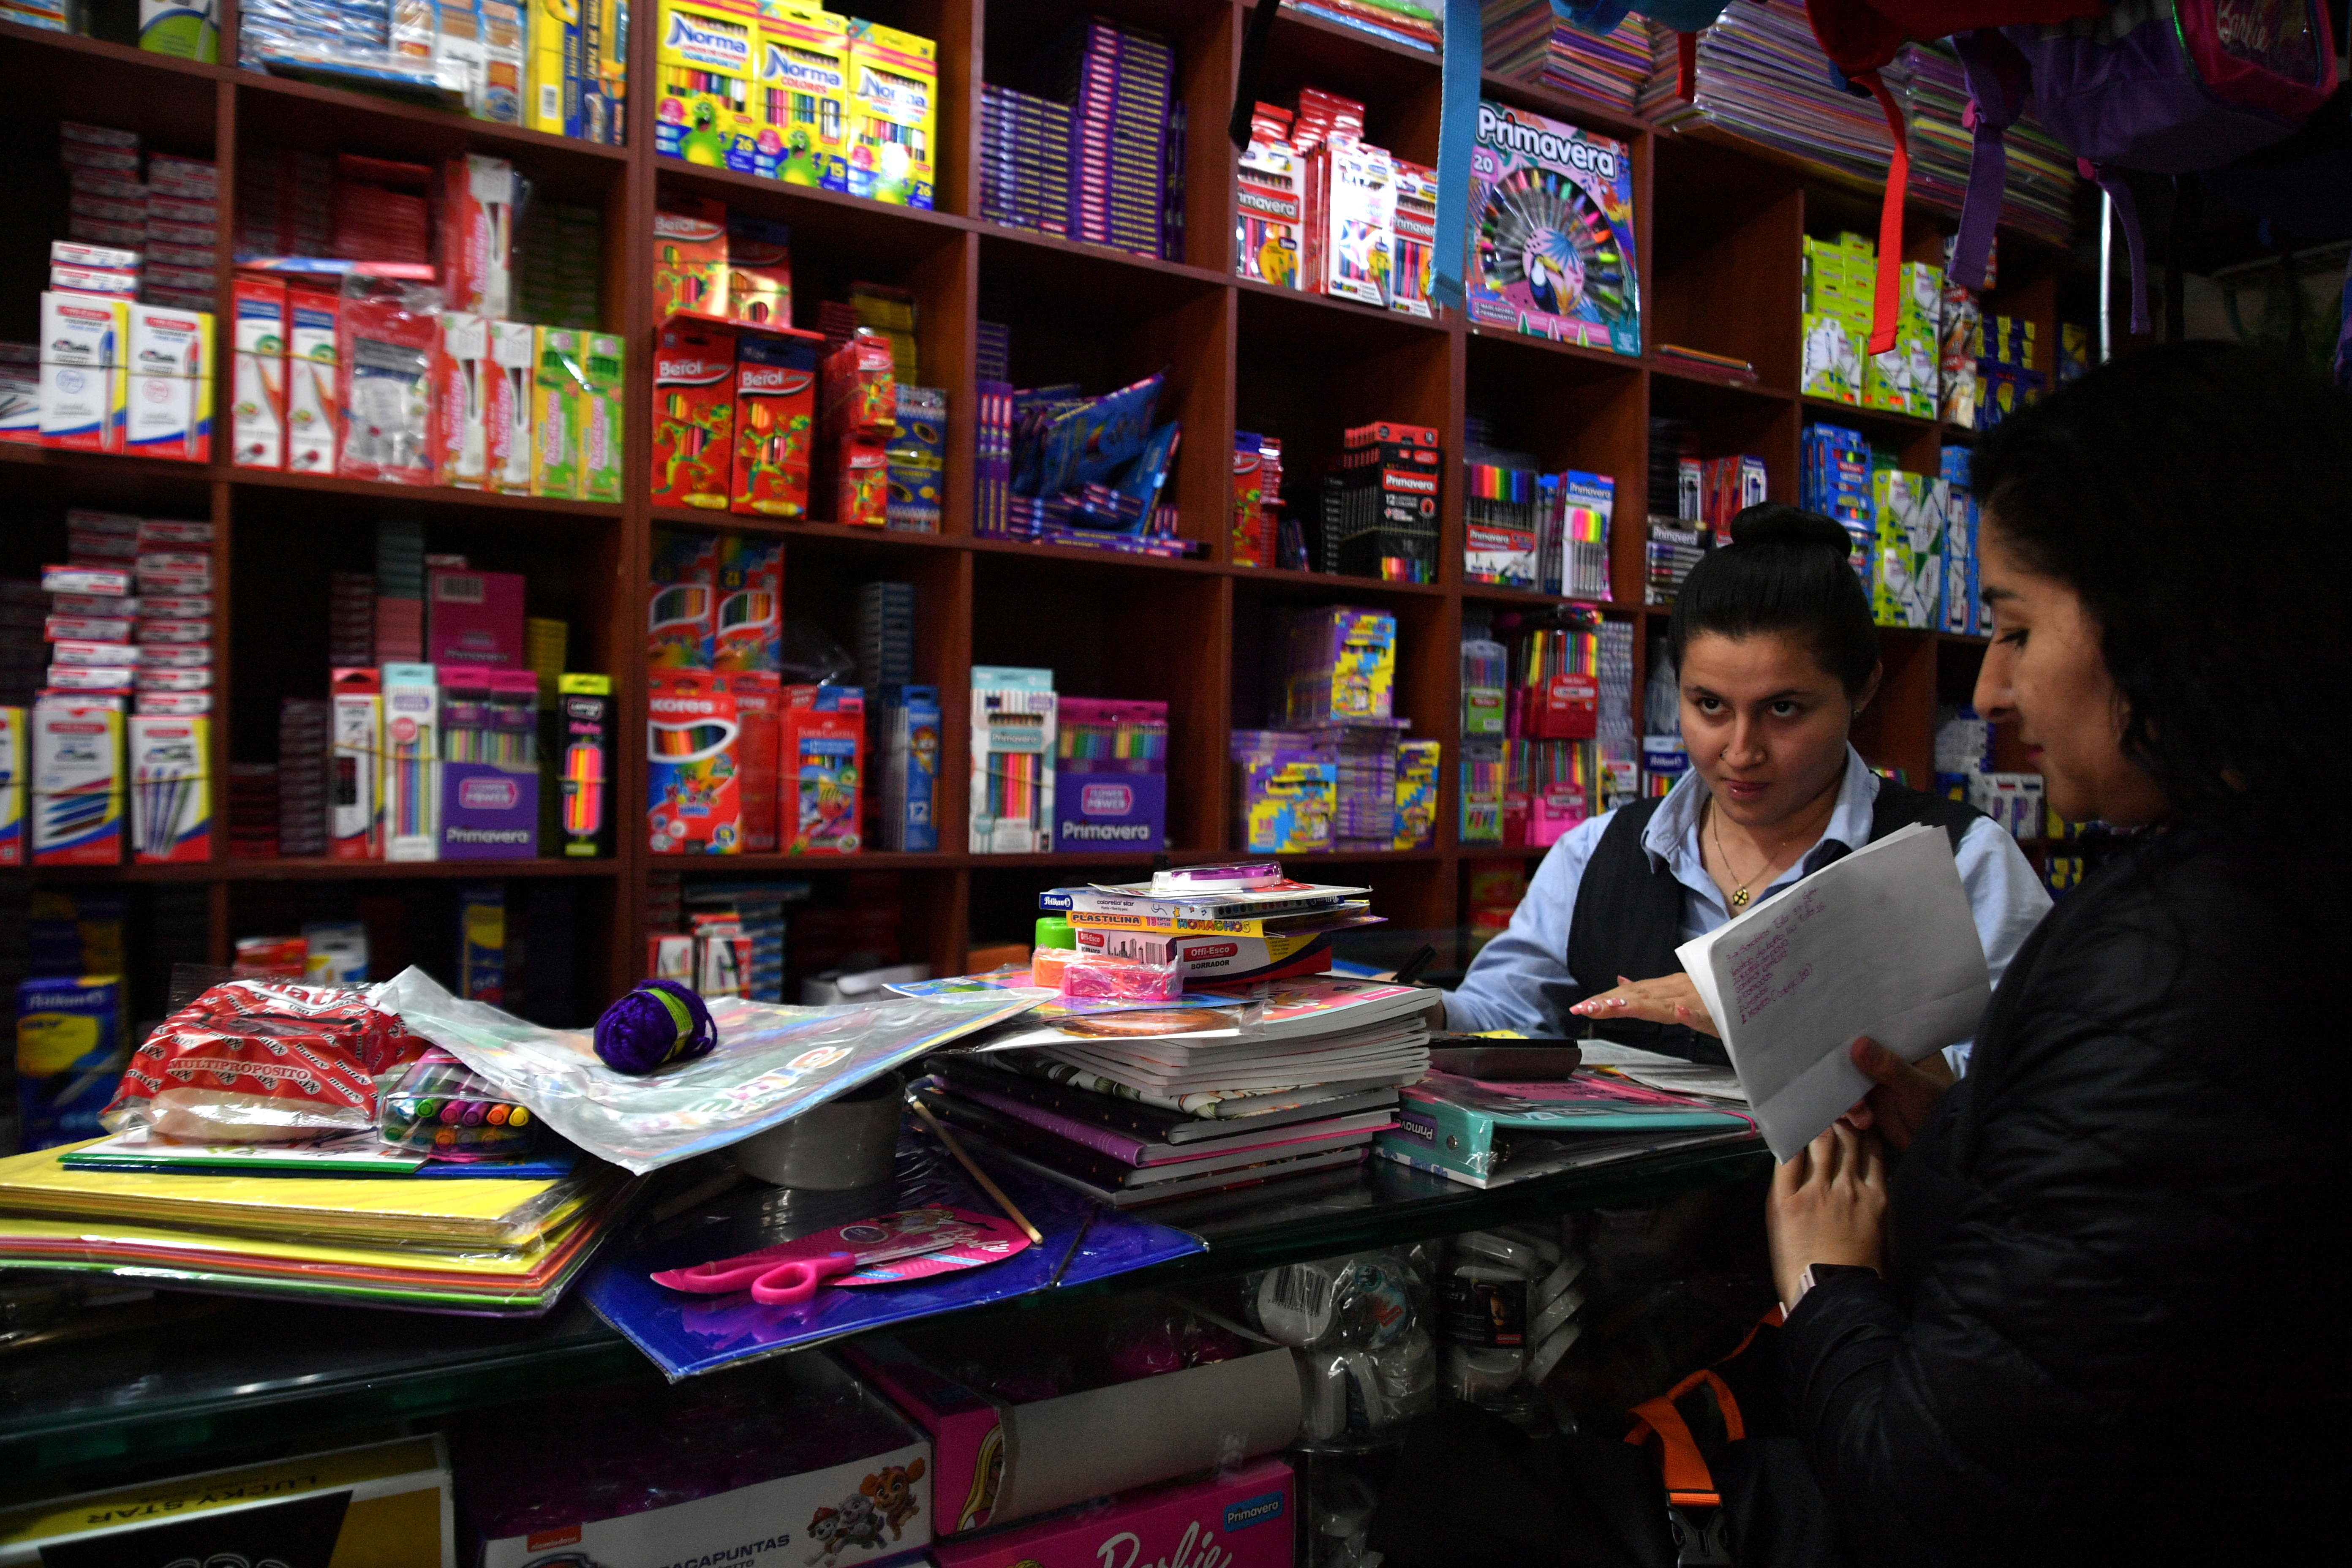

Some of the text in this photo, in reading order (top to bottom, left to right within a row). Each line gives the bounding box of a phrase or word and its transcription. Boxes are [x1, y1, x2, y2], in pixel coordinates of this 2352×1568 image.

[666, 13, 747, 53] Norma
[763, 44, 840, 86] Norma
[781, 76, 827, 94] COLORES
[736, 137, 754, 152] 26
[1478, 105, 1615, 178] Primavera
[830, 162, 845, 177] 15
[1473, 153, 1494, 174] 20
[917, 182, 931, 197] 26
[1238, 191, 1296, 217] imavera
[656, 215, 696, 232] Berol
[659, 359, 703, 376] Berol
[742, 370, 783, 387] Berol
[1386, 474, 1434, 491] Primavera
[1569, 482, 1612, 499] Primavera
[1470, 529, 1510, 544] Primavera
[1653, 527, 1697, 545] Primavera
[992, 733, 1037, 743] Primavera
[909, 801, 928, 822] 12
[446, 826, 530, 844] Primavera
[1062, 819, 1150, 841] Primavera
[1044, 896, 1064, 906] Pelikan
[1072, 913, 1141, 925] PLASTILINA
[1177, 918, 1251, 933] MONACHOS
[1081, 932, 1100, 943] Offi-Esco
[1191, 946, 1230, 957] Offi-Esco
[1191, 960, 1230, 970] BORRADOR
[289, 1000, 350, 1015] USO GENERA
[297, 1044, 329, 1069] matix
[170, 1059, 309, 1078] MULTIPROPOSITO
[336, 1060, 370, 1085] matix
[128, 1069, 161, 1092] matix
[329, 1078, 364, 1103] matix
[929, 1227, 1009, 1252] Barbie
[87, 1475, 318, 1524] LUCKY STAR
[1227, 1500, 1279, 1524] Primavera
